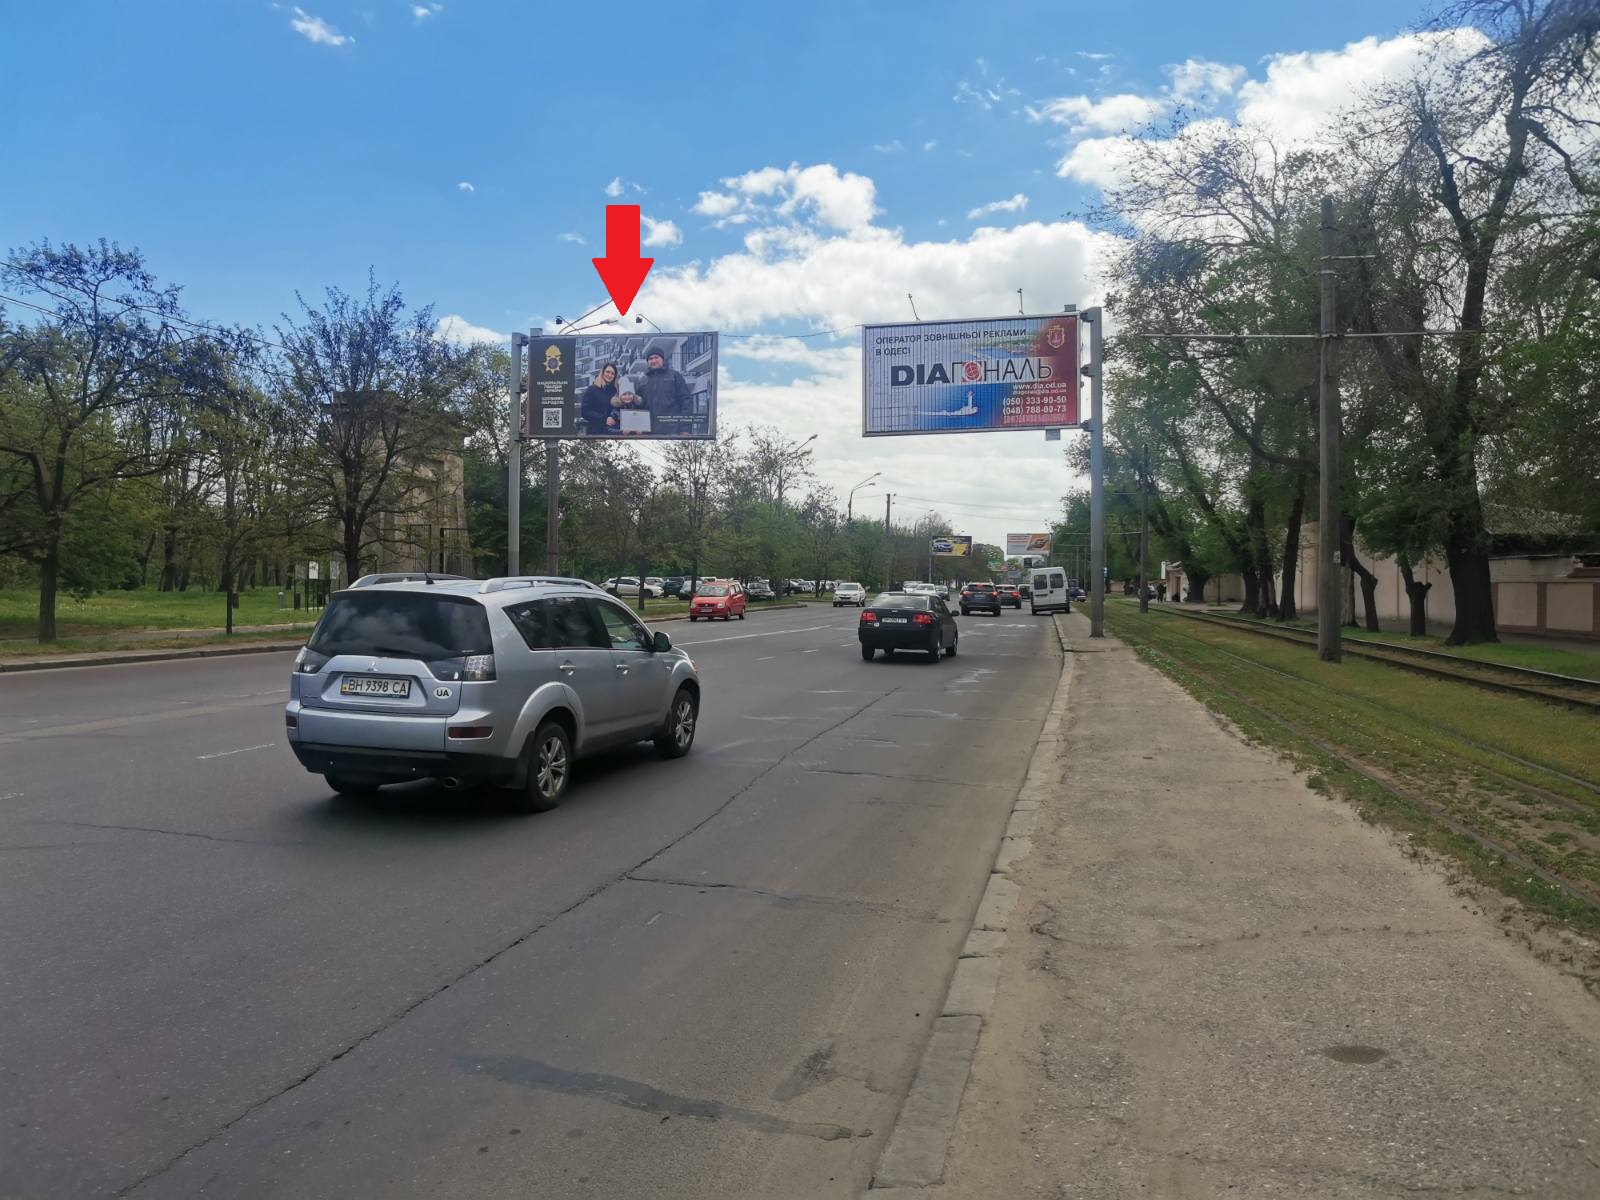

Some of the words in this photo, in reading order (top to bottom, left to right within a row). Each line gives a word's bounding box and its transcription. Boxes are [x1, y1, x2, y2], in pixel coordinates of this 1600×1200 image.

[875, 335, 922, 345] ОПЕРАТОР
[984, 328, 1027, 339] РЕКЛАМИ
[875, 348, 881, 356] В
[883, 347, 911, 357] ОДЕСІ
[1012, 382, 1067, 390] www.dia.od.ua
[1003, 397, 1024, 406] (050)
[1026, 396, 1067, 404] 333-90-50
[1003, 406, 1024, 415] (048)
[1026, 405, 1067, 414] 788-00-73
[365, 680, 389, 692] 9398
[436, 688, 450, 697] UA
